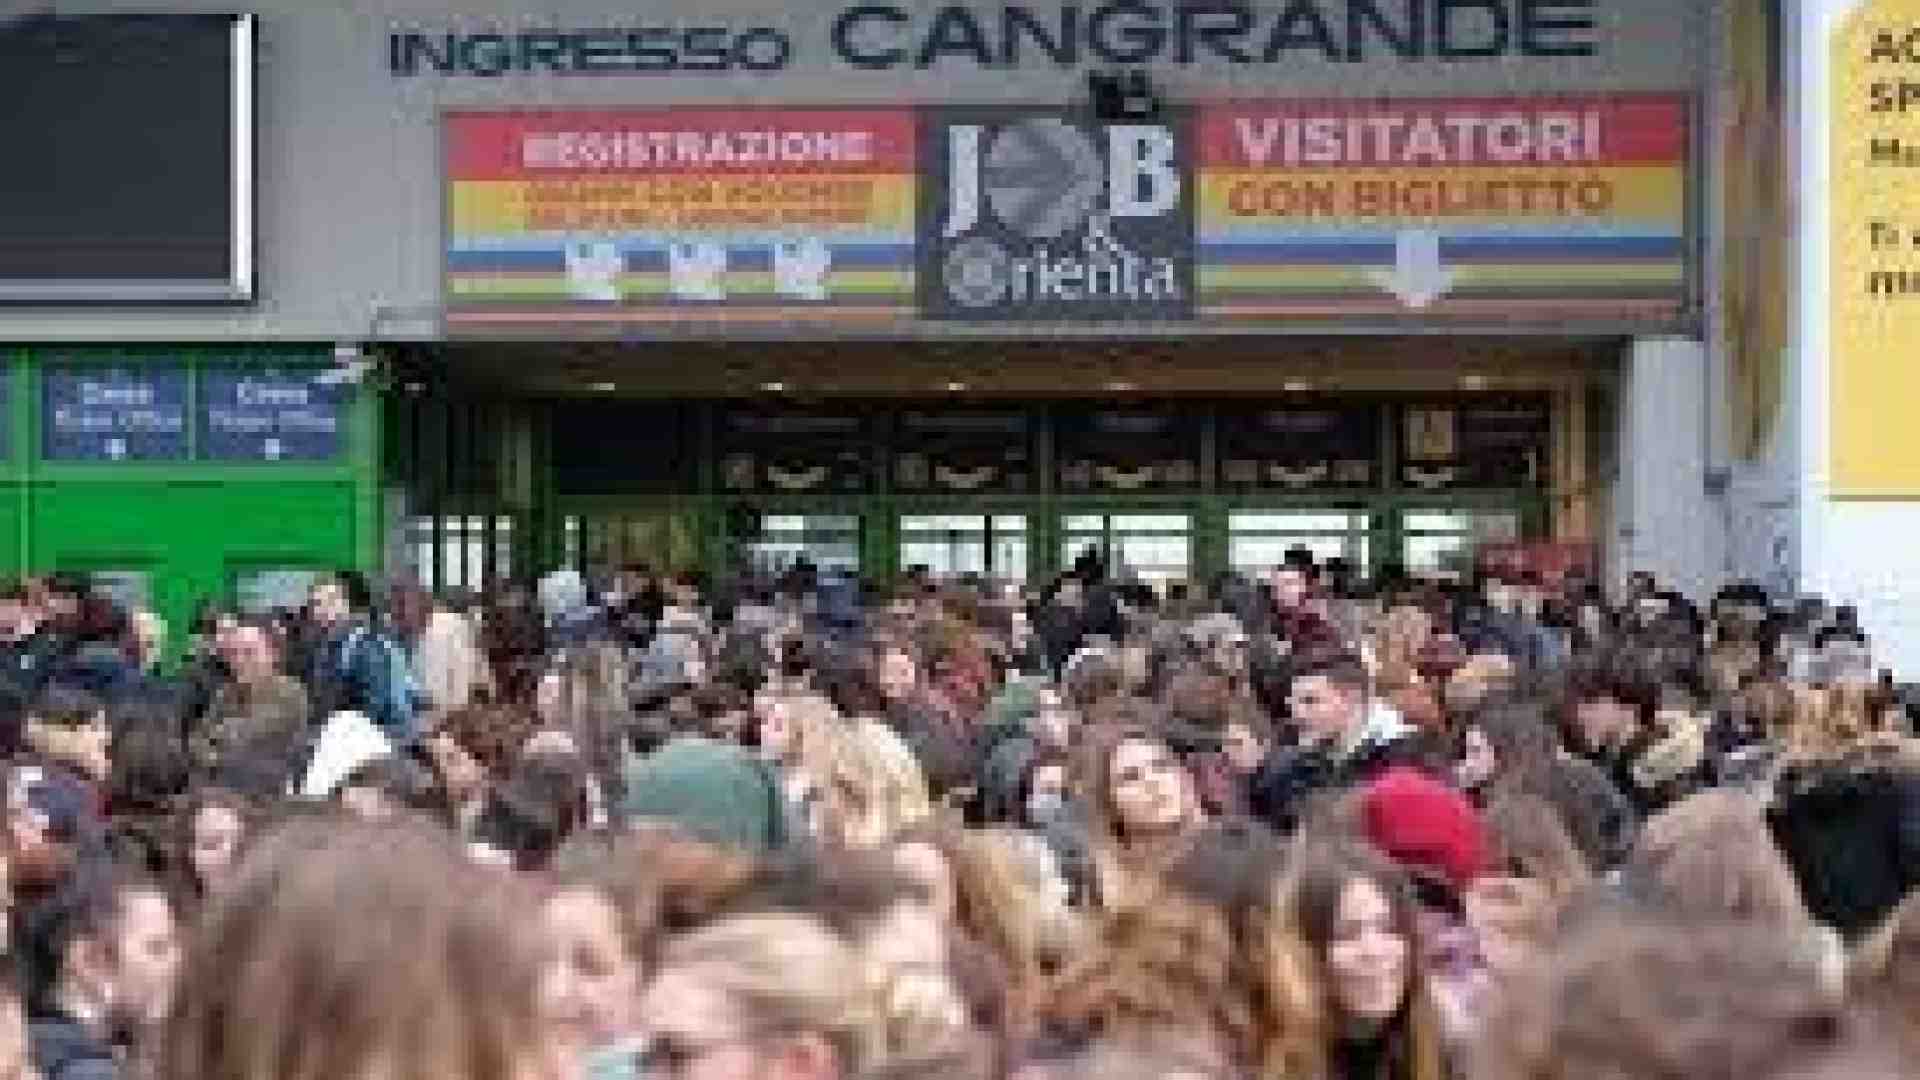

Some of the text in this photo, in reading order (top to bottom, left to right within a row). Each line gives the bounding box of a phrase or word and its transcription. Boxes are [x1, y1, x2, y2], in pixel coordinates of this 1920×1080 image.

[389, 0, 1598, 77] INGRESSO CANGRANDE
[1235, 110, 1602, 165] VISITATORI
[1227, 177, 1614, 217] CON BIGLIETTO
